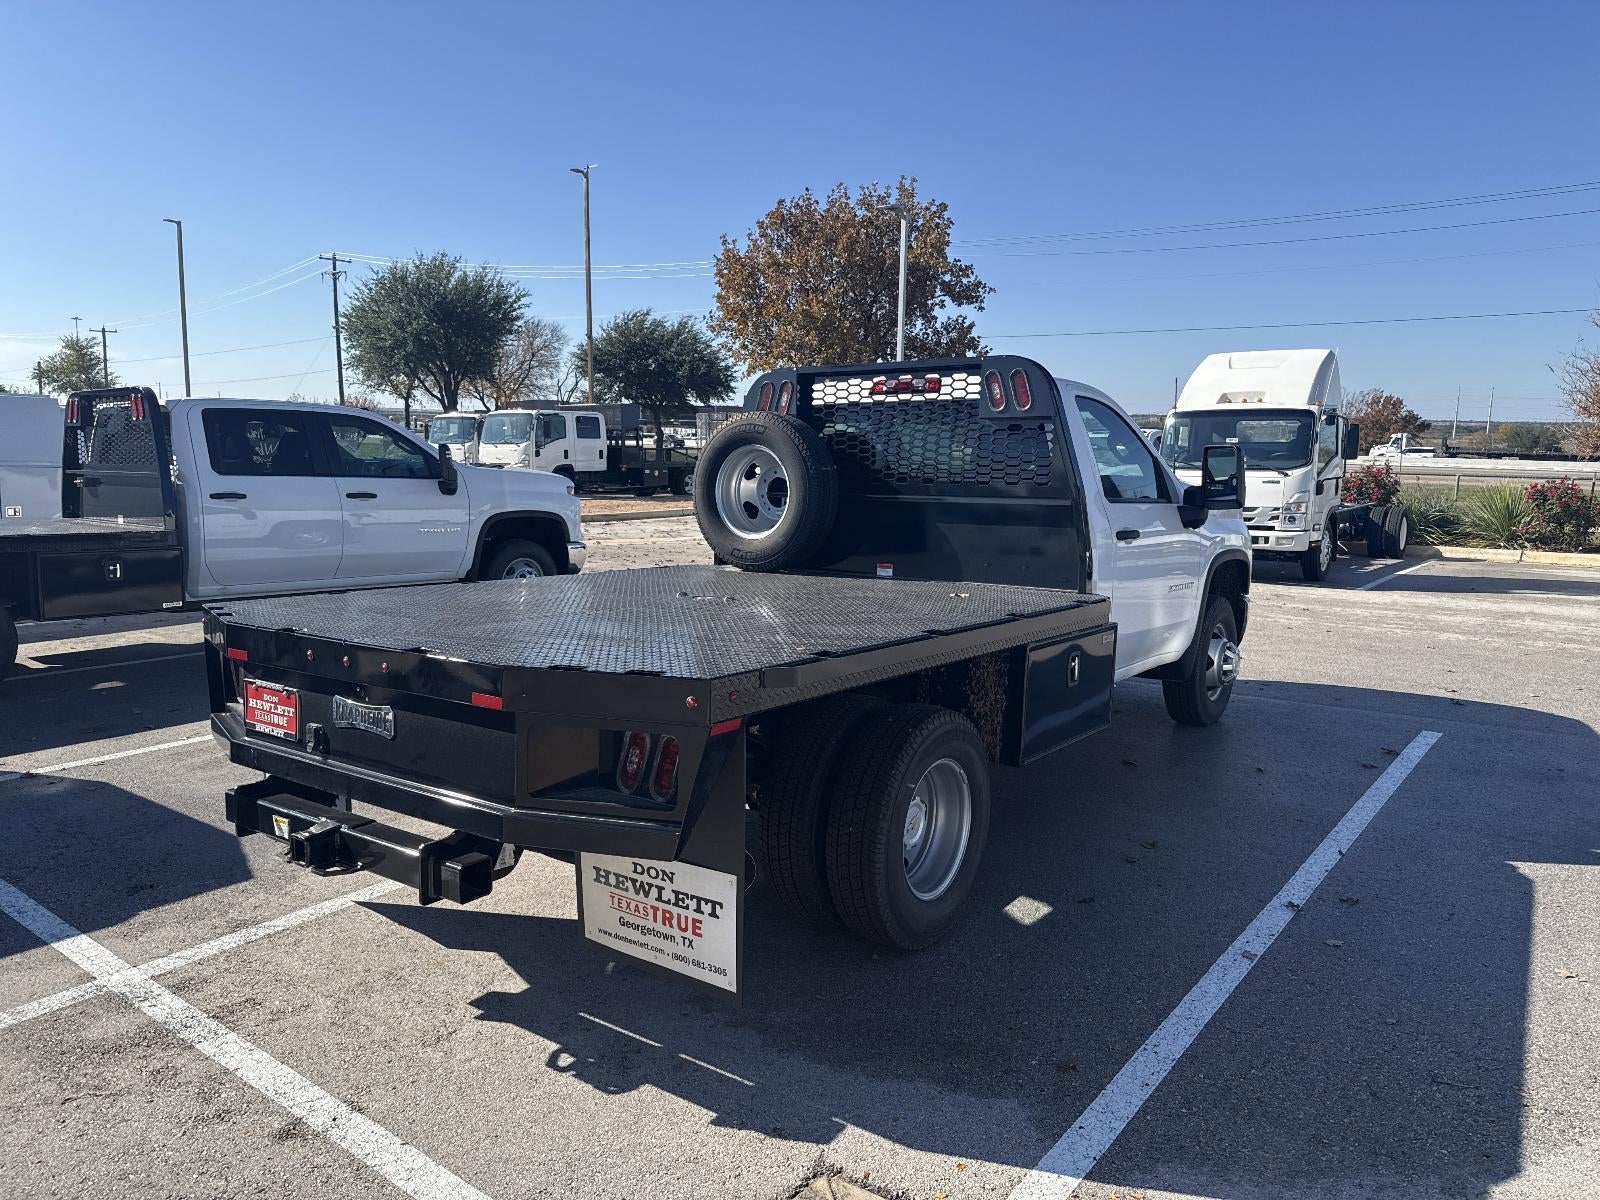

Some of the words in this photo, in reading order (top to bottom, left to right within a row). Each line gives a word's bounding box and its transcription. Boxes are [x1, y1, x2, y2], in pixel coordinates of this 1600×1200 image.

[248, 698, 295, 717] HEWLETT
[263, 693, 279, 703] DON
[631, 861, 676, 885] DON
[592, 865, 724, 919] HEWLETT
[618, 916, 679, 946] Georgetown,
[681, 935, 695, 950] TX
[597, 927, 665, 956] www.donhewlett.com
[671, 952, 691, 967] (800)
[691, 958, 728, 977] 681-3305
